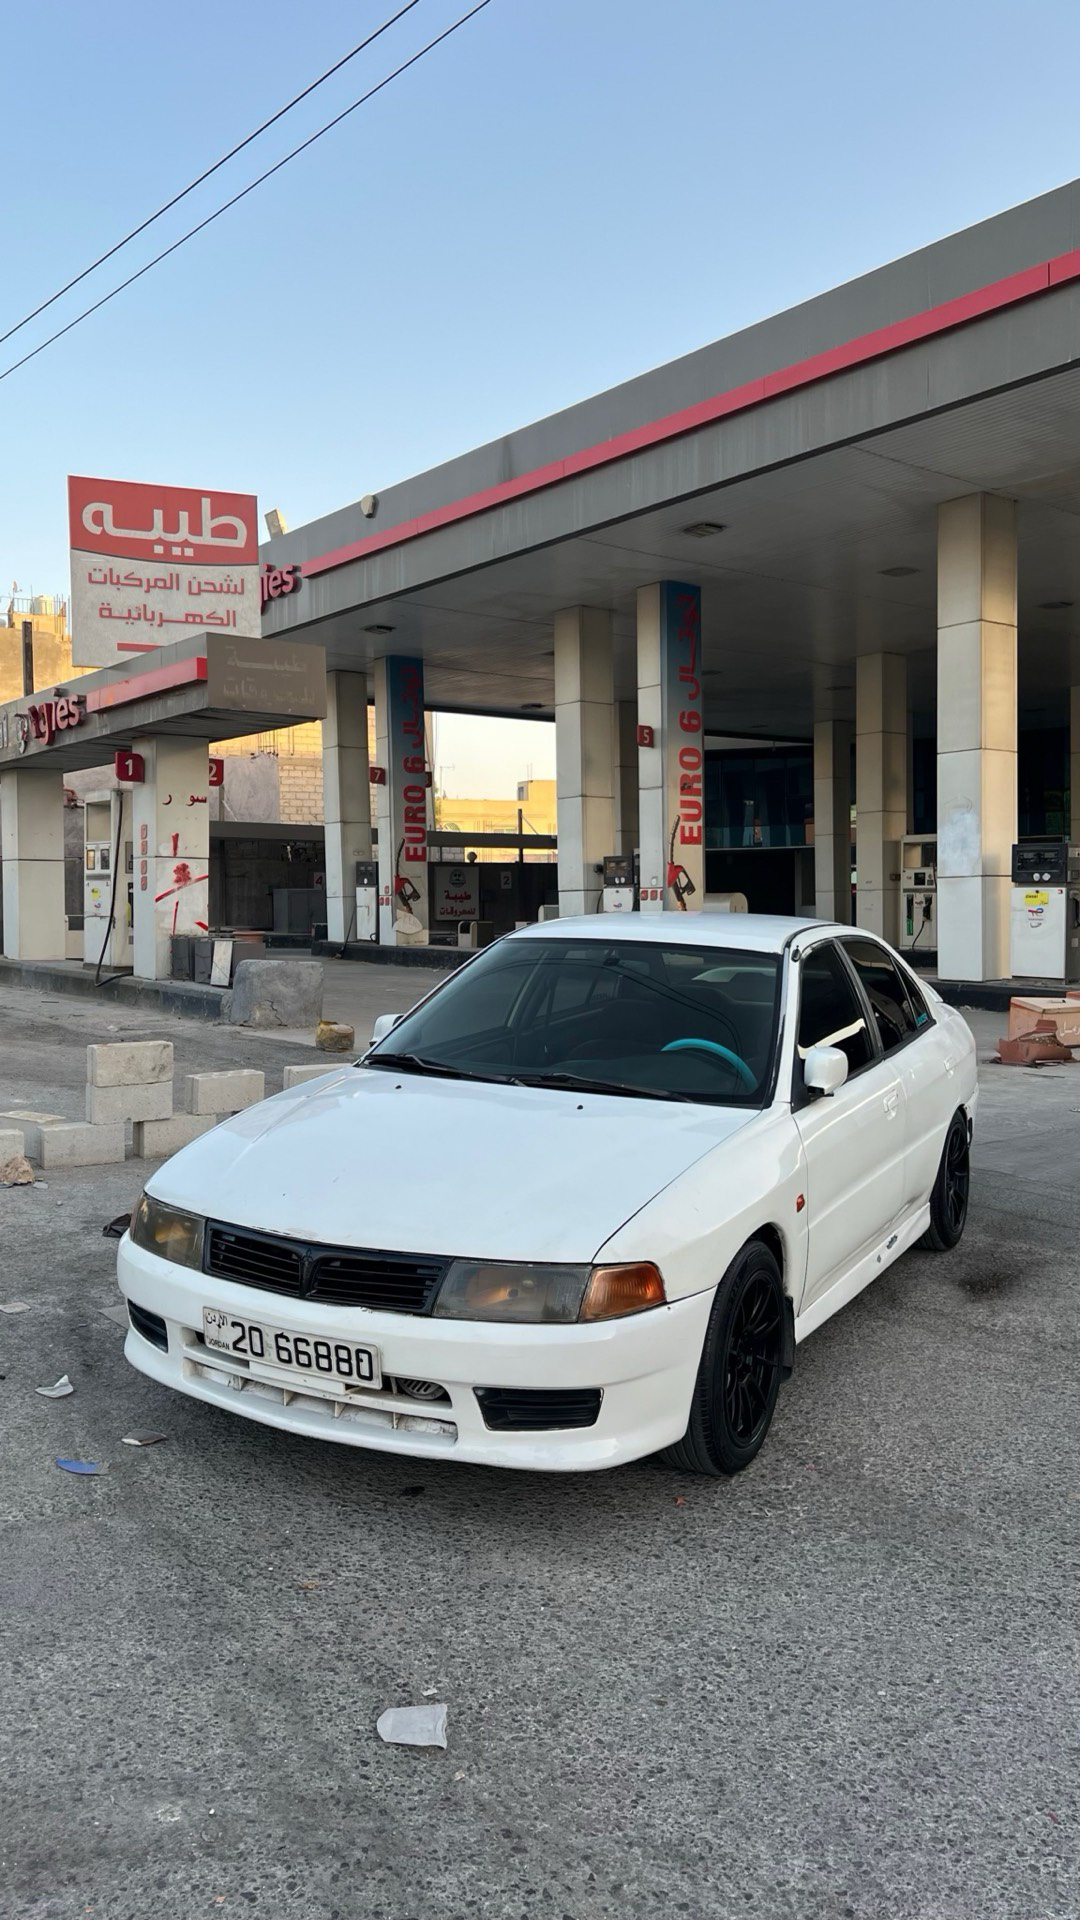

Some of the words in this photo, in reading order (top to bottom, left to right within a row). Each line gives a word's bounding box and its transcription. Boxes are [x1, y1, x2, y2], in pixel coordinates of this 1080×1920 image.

[87, 567, 180, 594] المركبات
[187, 574, 245, 596] لشحن
[98, 603, 237, 628] الكهربائية
[679, 710, 702, 734] 6
[643, 730, 650, 744] 5
[125, 759, 133, 776] 1
[209, 766, 217, 781] 2
[374, 769, 381, 781] 7
[403, 756, 426, 774] 6
[679, 747, 703, 845] EURO
[403, 786, 427, 862] EURO
[503, 875, 510, 885] 2
[208, 1338, 230, 1350] JORDAN
[231, 1320, 265, 1357] 20
[274, 1332, 374, 1382] 66880
